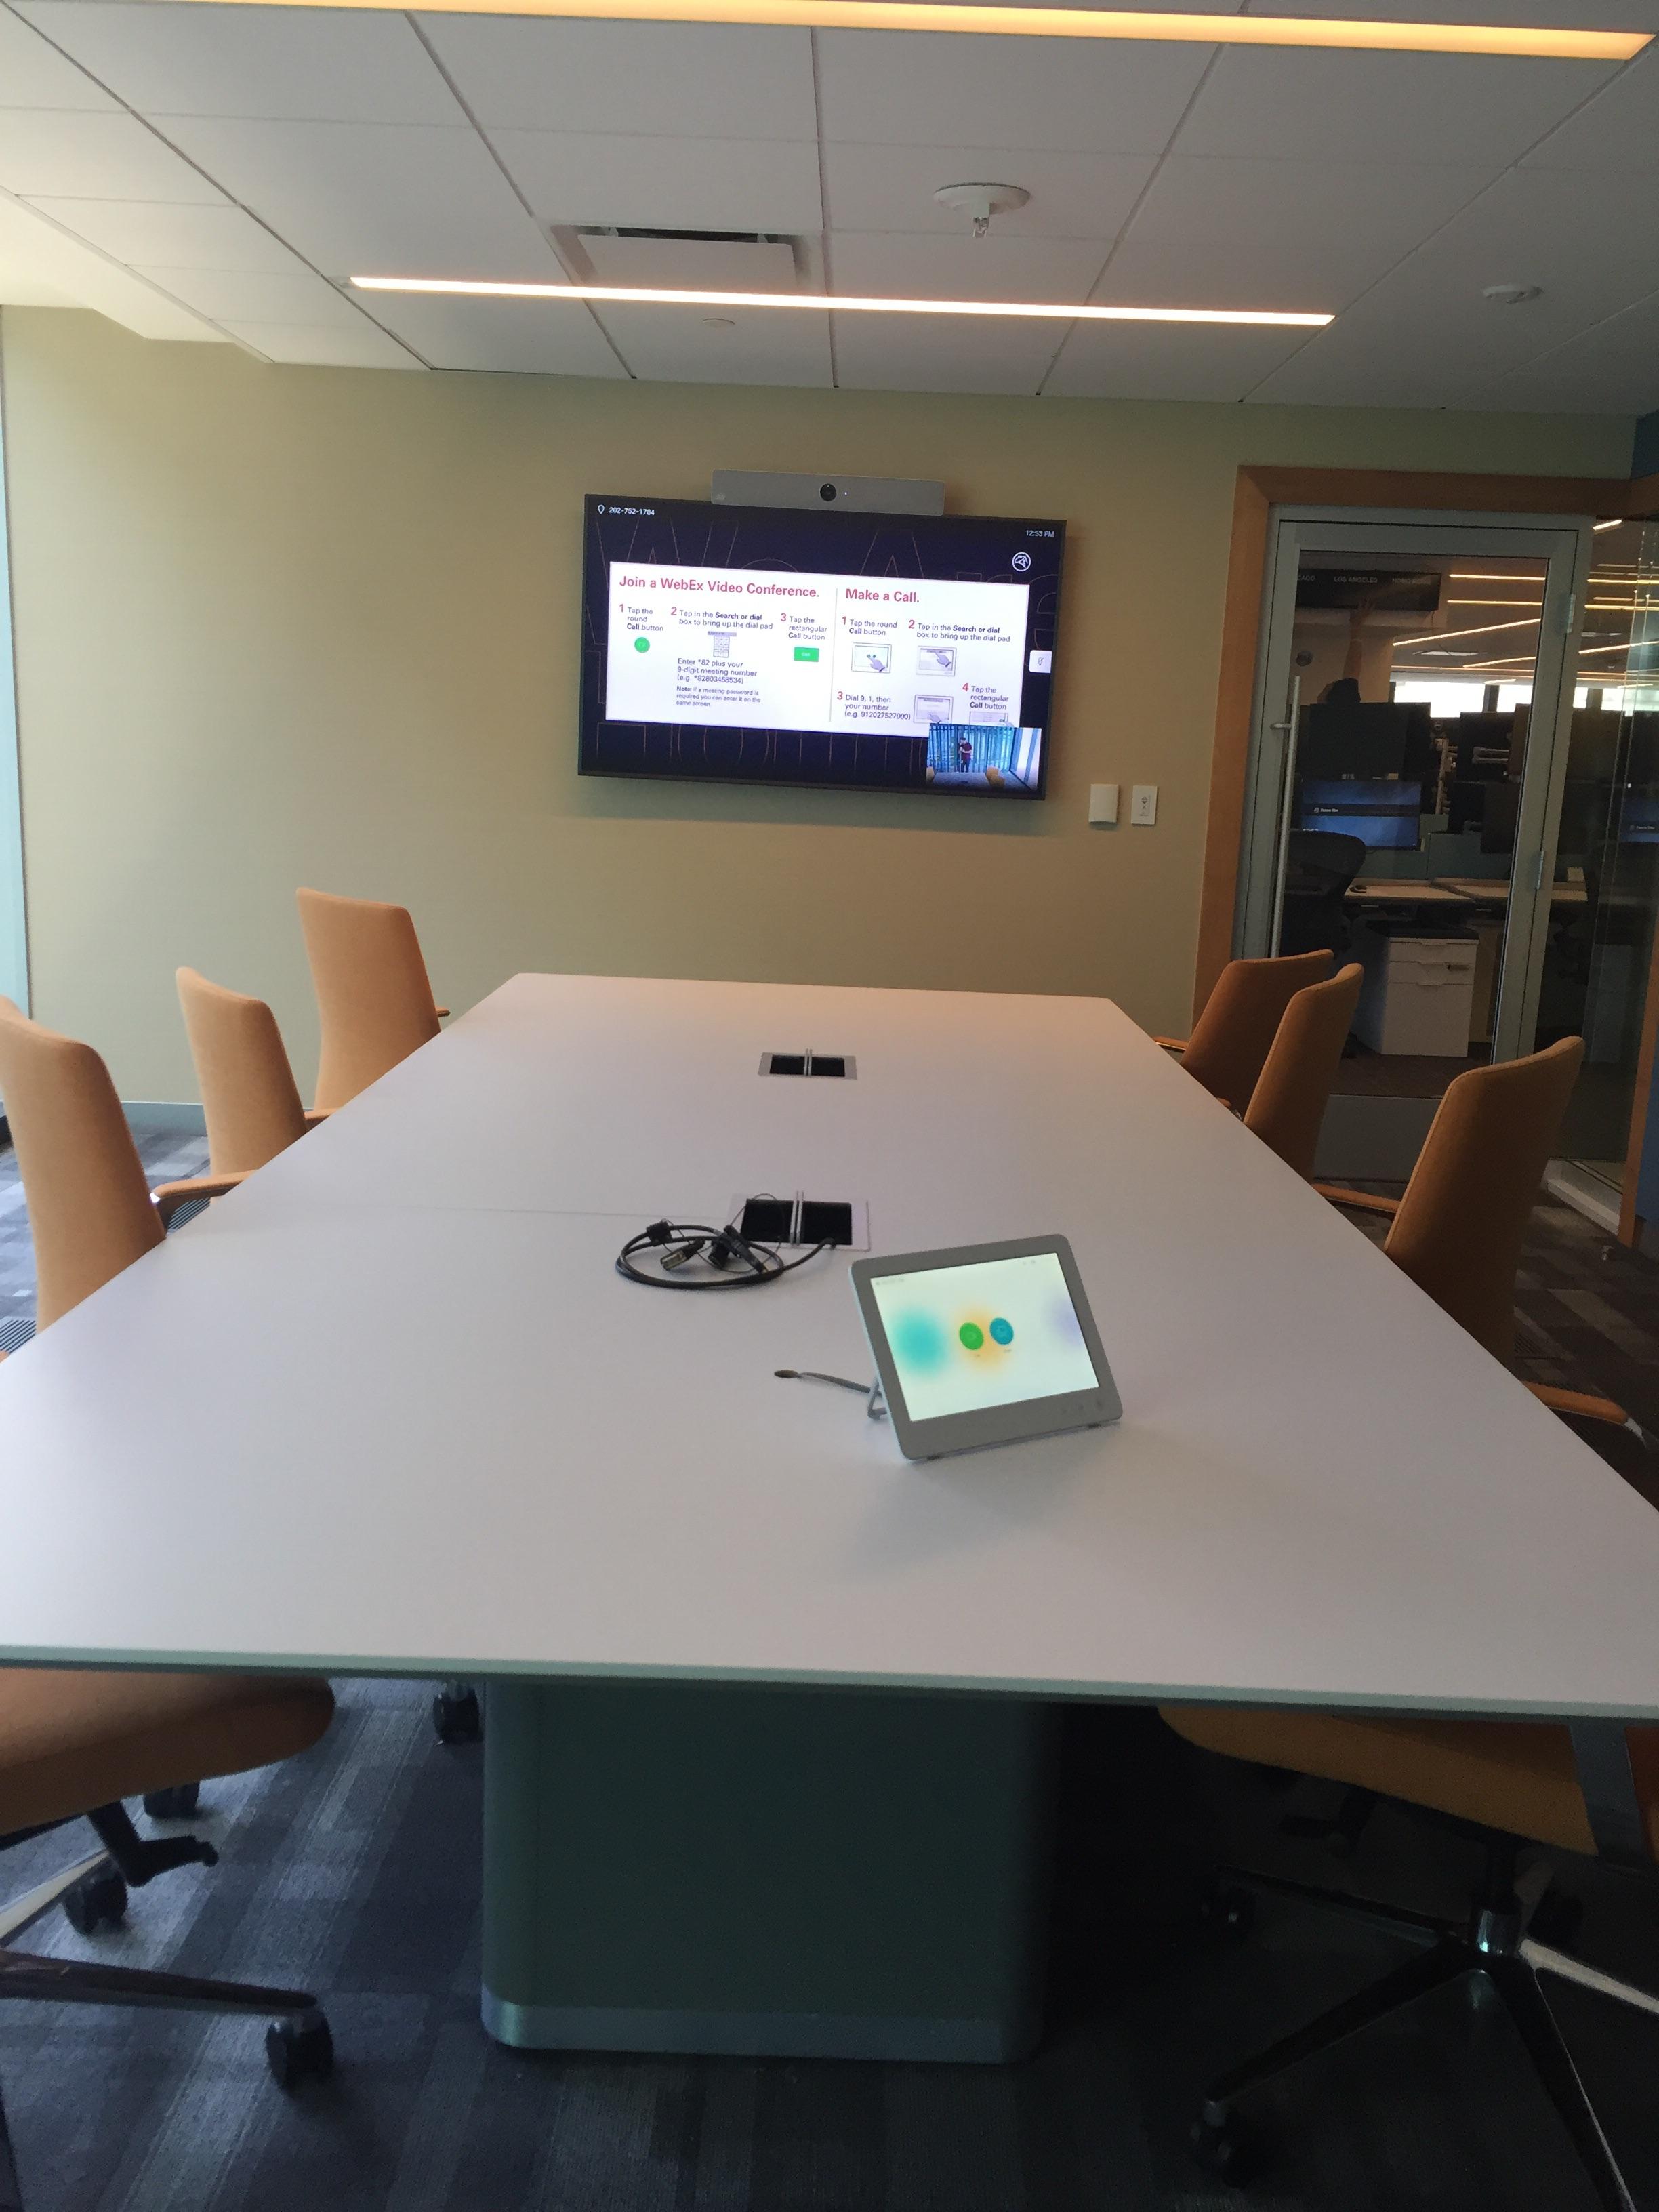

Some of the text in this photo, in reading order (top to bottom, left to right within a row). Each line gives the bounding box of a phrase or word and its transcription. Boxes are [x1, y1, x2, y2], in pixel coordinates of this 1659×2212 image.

[609, 506, 655, 516] 202-752-1784
[619, 575, 819, 598] Join a WebEx Video Conference.
[846, 588, 920, 603] Make a Call.
[619, 603, 624, 613] 1
[628, 607, 640, 615] Tap
[671, 606, 677, 616] 2
[680, 609, 693, 617] Tap
[715, 611, 739, 619] Search
[781, 613, 787, 622] 3
[842, 616, 846, 626] 1
[850, 619, 862, 627] Tap
[703, 619, 720, 628] bring
[789, 625, 827, 633] rectangular
[908, 619, 915, 629] 2
[953, 625, 977, 633] Search
[940, 633, 958, 641] bring
[997, 636, 1010, 644] pad
[678, 666, 699, 675] 9-digit
[701, 668, 729, 676] meeting
[962, 682, 969, 692] 4
[971, 685, 984, 694] Tap
[837, 691, 843, 700] 3
